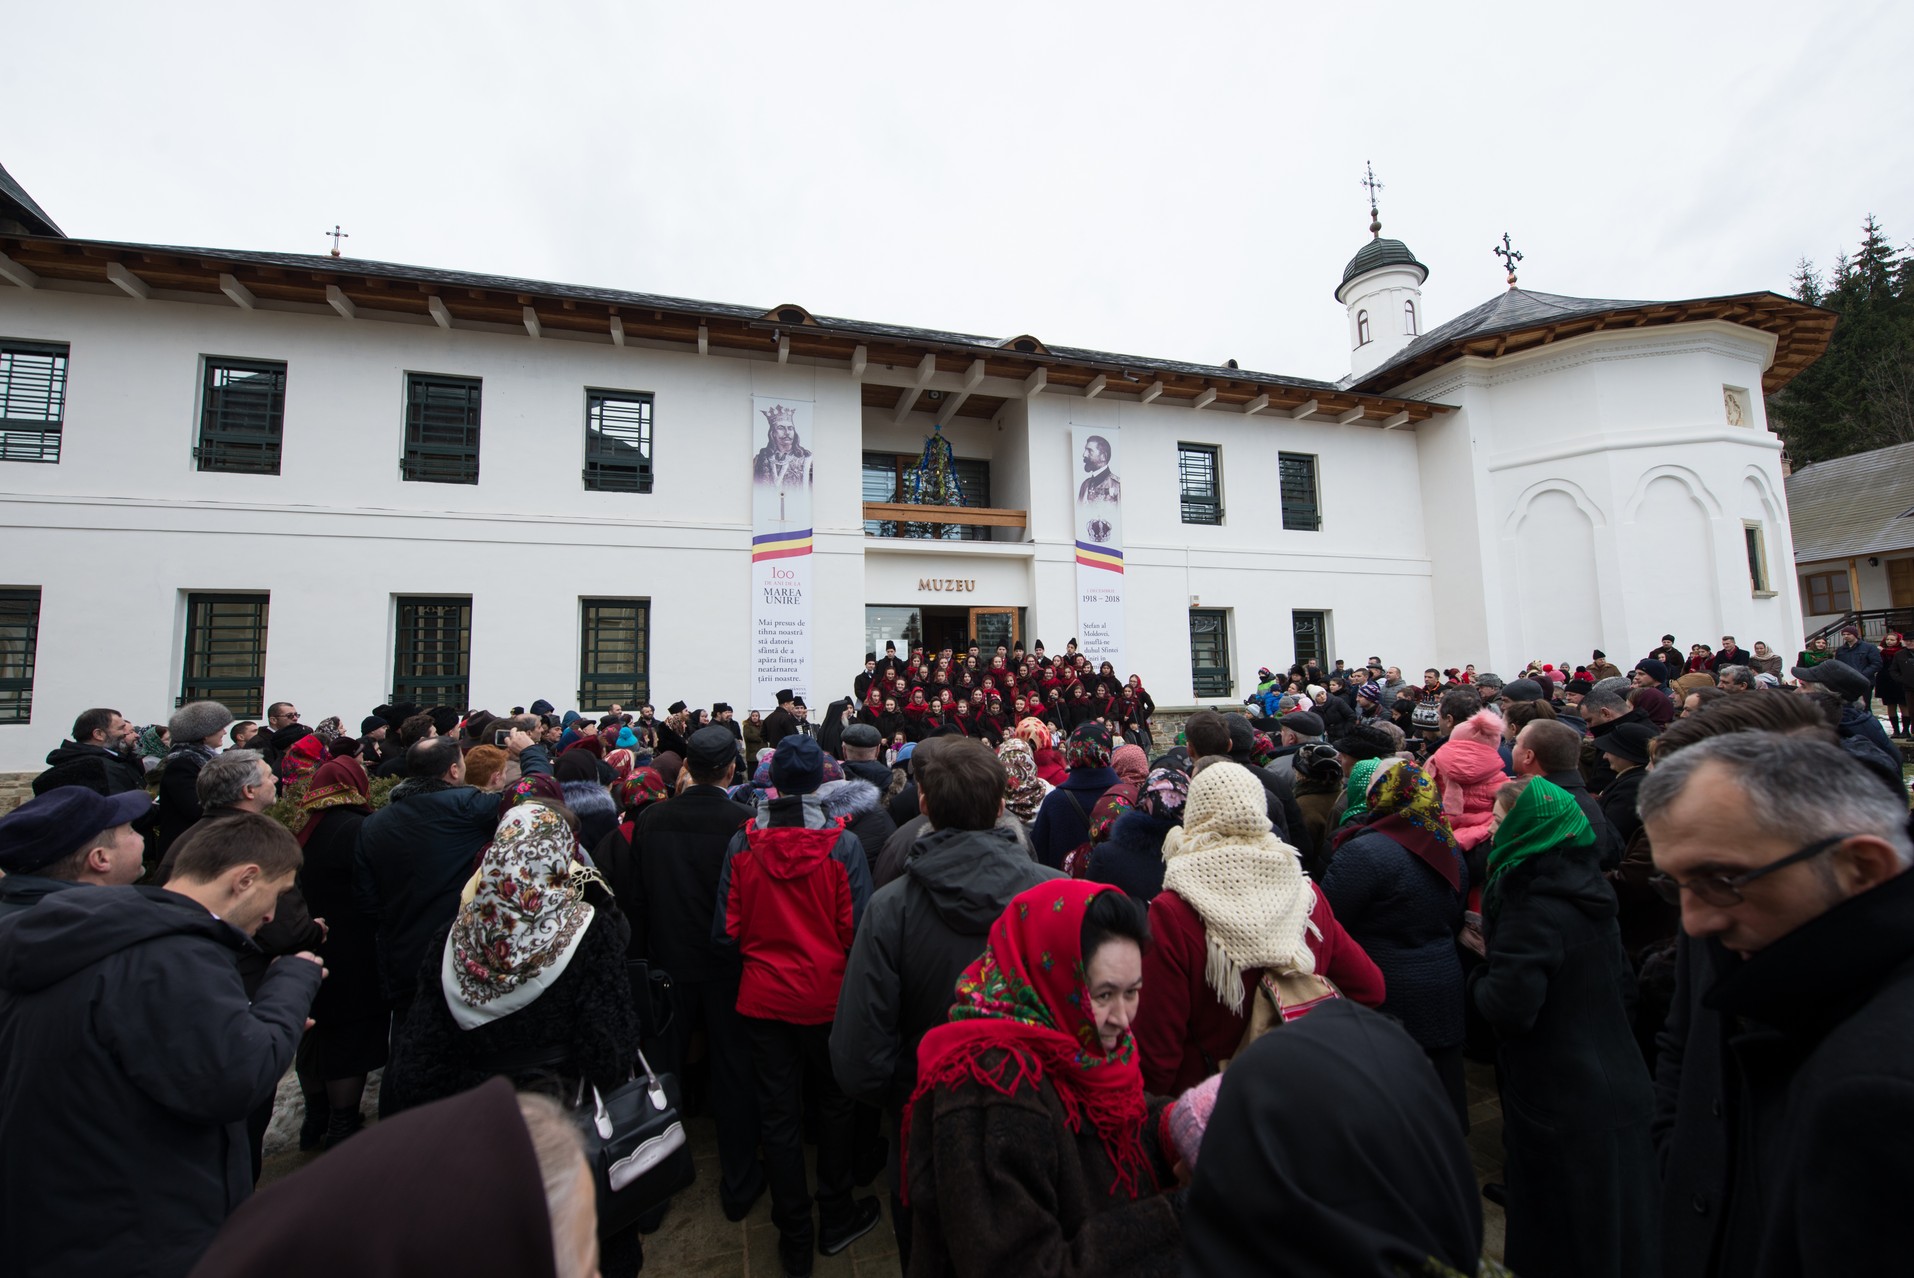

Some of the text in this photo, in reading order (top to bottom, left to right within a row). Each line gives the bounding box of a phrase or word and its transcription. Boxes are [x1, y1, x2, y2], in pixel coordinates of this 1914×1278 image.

[772, 567, 795, 579] 100
[918, 579, 976, 592] MUZEU
[764, 588, 802, 596] MAREA
[765, 596, 801, 605] UNIRE
